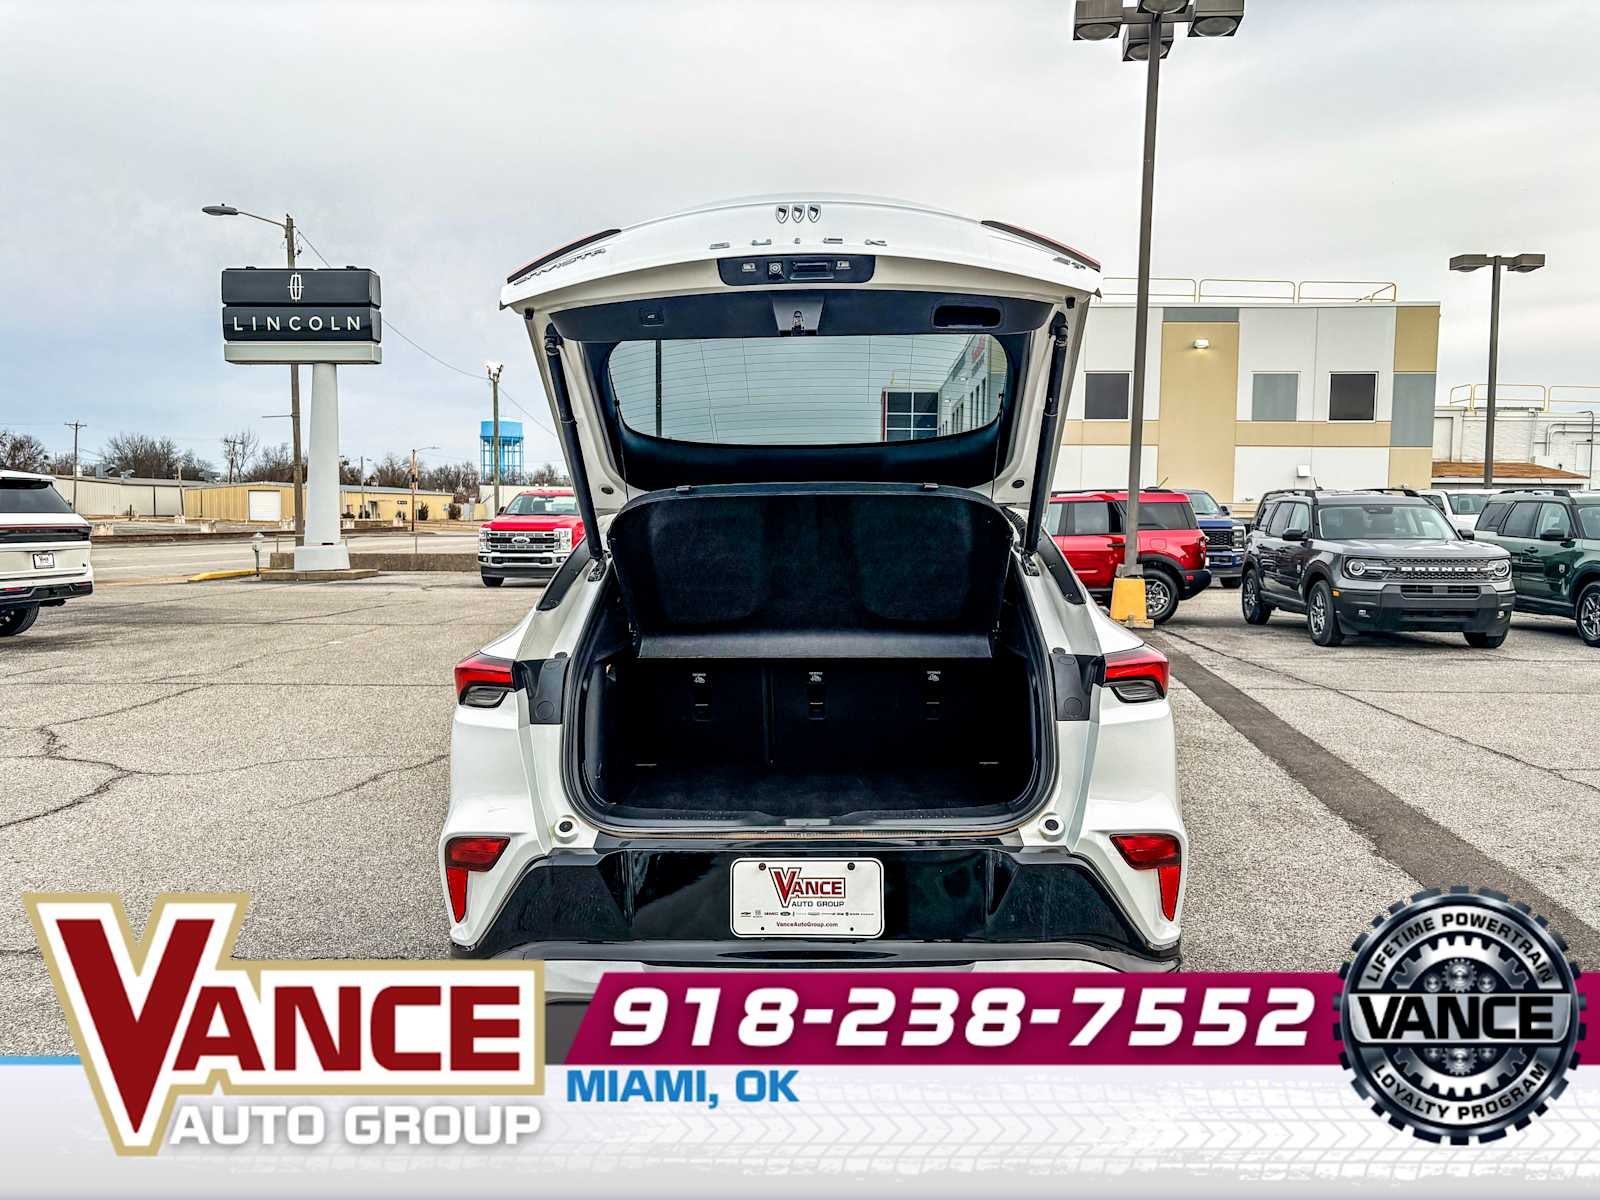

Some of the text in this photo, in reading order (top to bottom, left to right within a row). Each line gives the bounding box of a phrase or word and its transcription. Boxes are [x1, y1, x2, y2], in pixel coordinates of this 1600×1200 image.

[233, 316, 361, 331] LINCOLN
[773, 870, 842, 904] VANCE
[791, 900, 845, 908] AUTO GROUP
